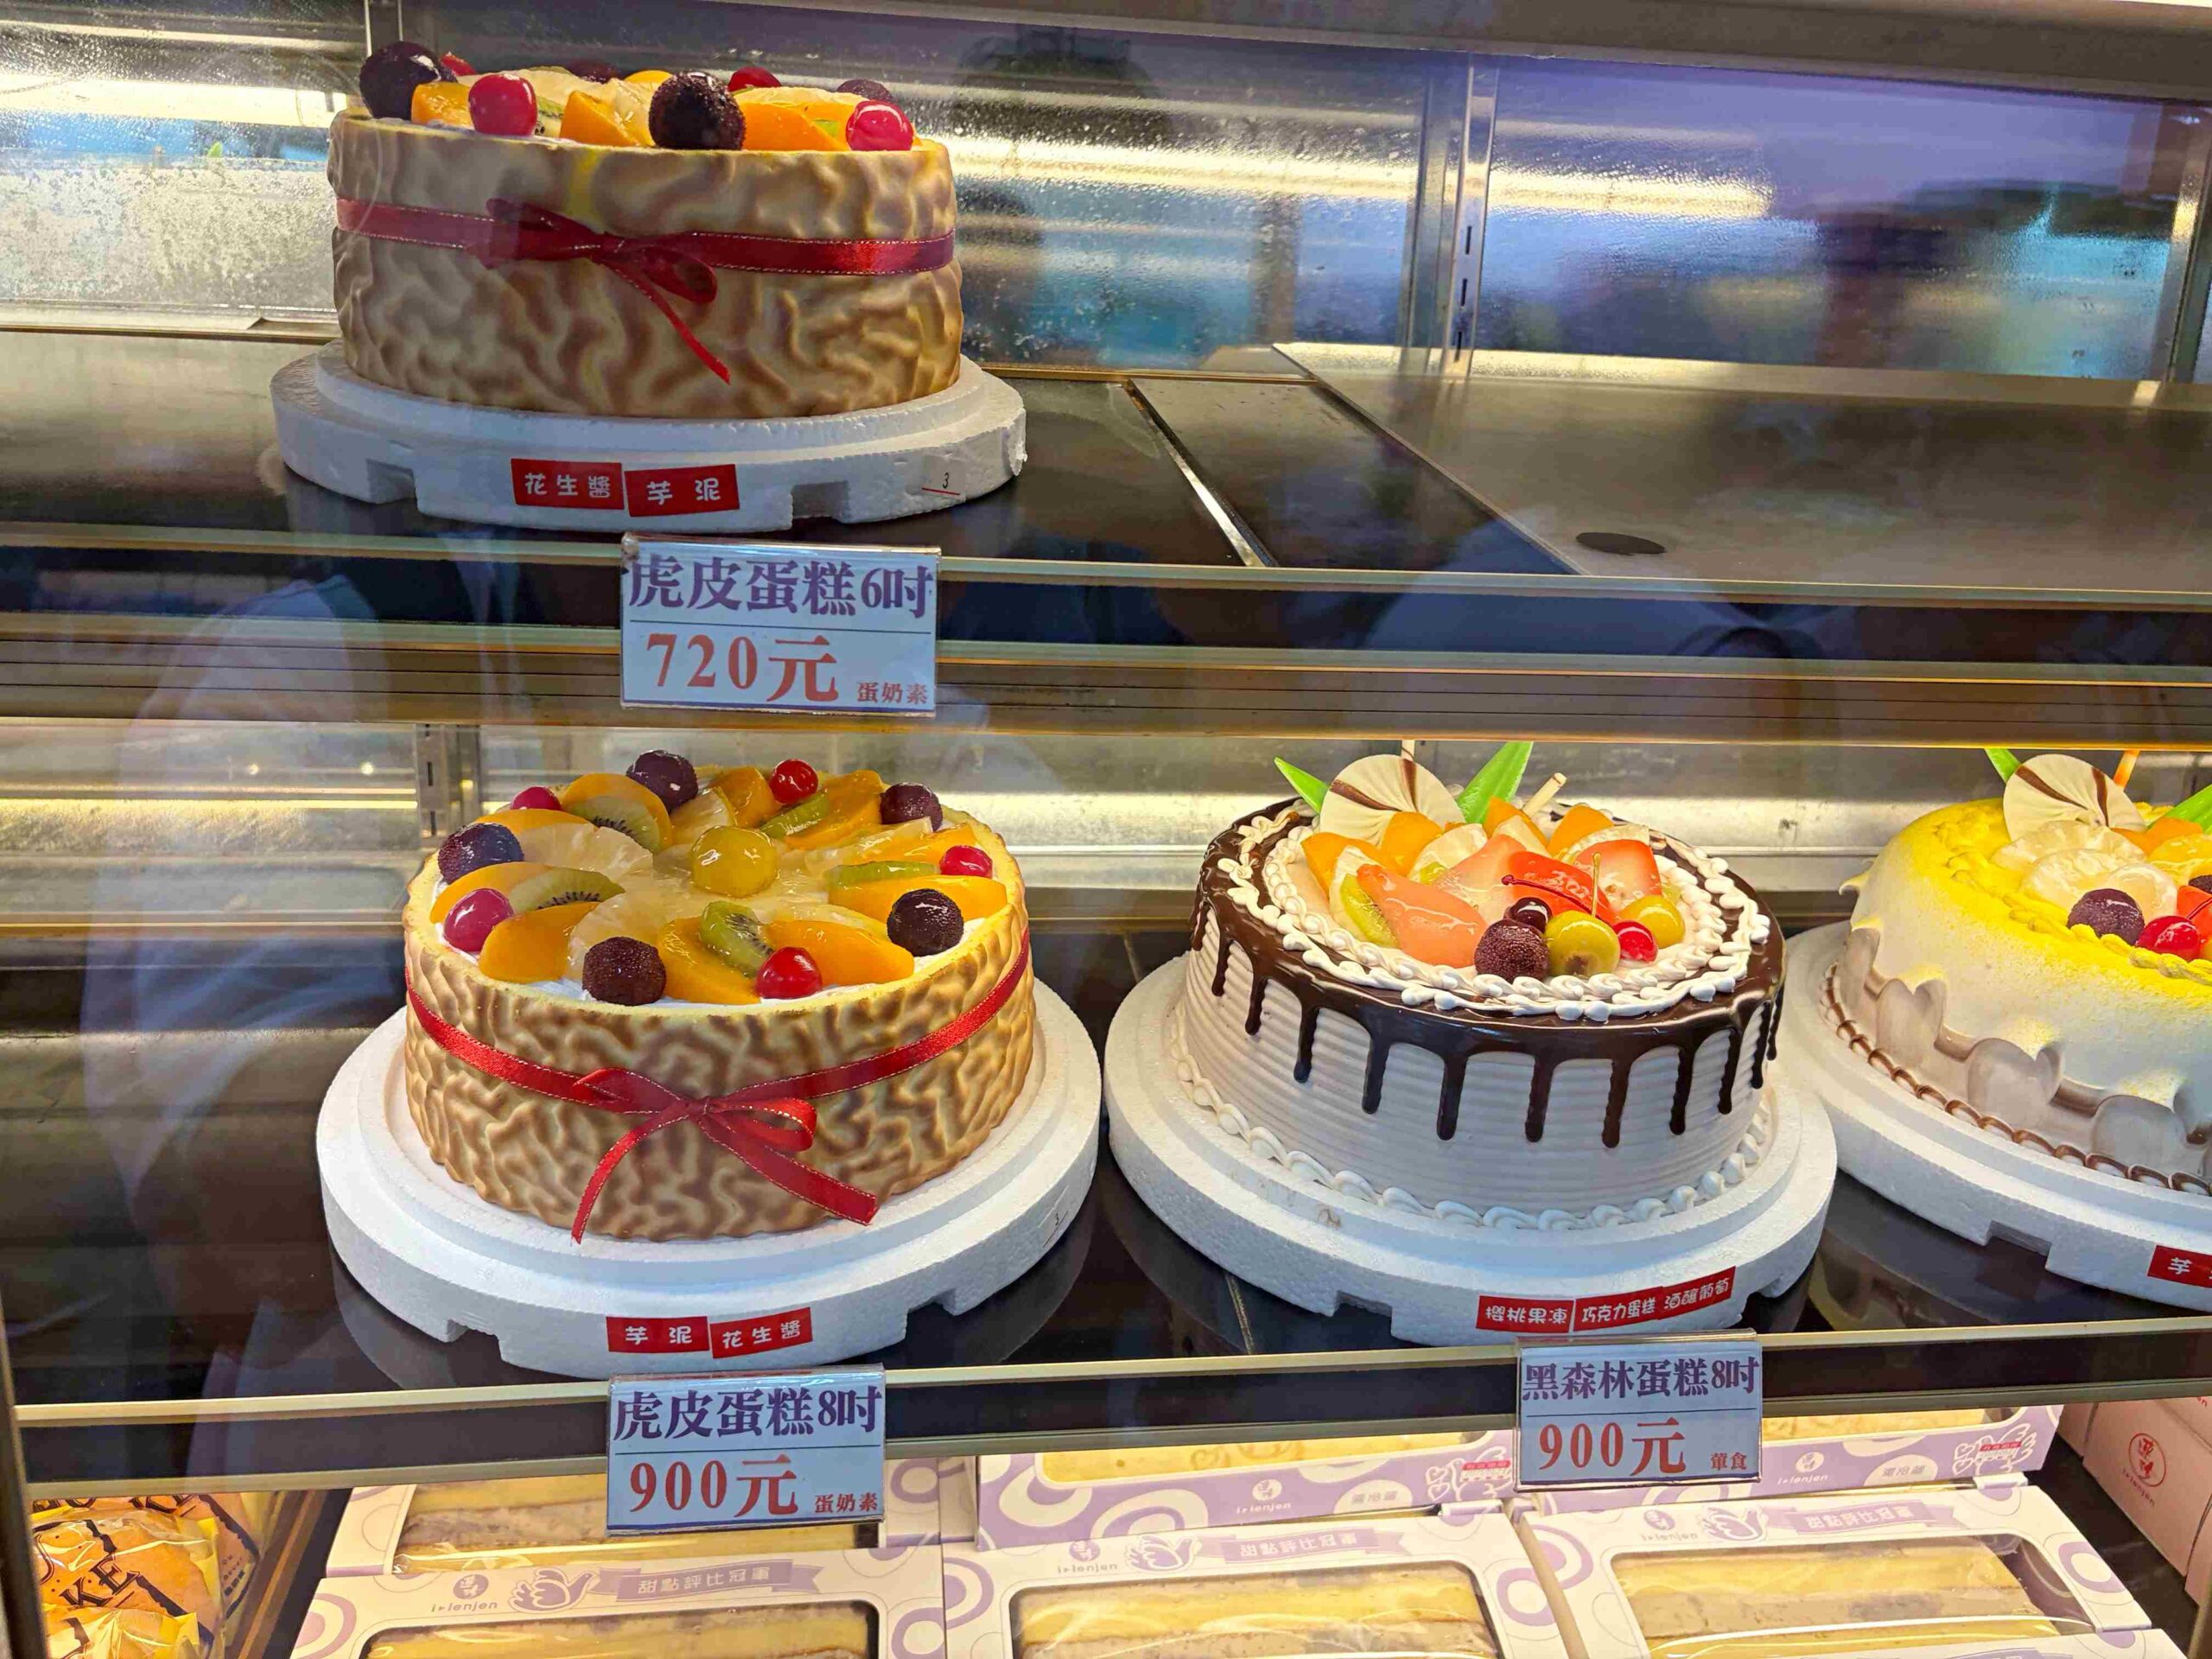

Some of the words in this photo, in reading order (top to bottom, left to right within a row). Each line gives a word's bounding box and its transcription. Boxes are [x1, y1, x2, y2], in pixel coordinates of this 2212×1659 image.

[524, 473, 611, 499] 花生醬
[645, 477, 721, 504] 芋泥
[628, 554, 934, 620] 虎皮蛋糕6吋
[646, 633, 840, 702] 720元
[856, 681, 929, 704] 蛋奶素
[1485, 1306, 1568, 1325] 櫻桃果凍
[1581, 1296, 1656, 1324] 巧克力蛋糕
[625, 1326, 693, 1344] 芋泥
[722, 1319, 801, 1349] 花生醬
[1522, 1357, 1760, 1402] 黑森林蛋糕8吋
[613, 1385, 883, 1441] 虎皮蛋糕8吋
[1538, 1416, 1687, 1477] 900元
[629, 1453, 799, 1518] 900元
[814, 1493, 879, 1514] 蛋奶素
[638, 1567, 771, 1594] 甜點評比冠軍
